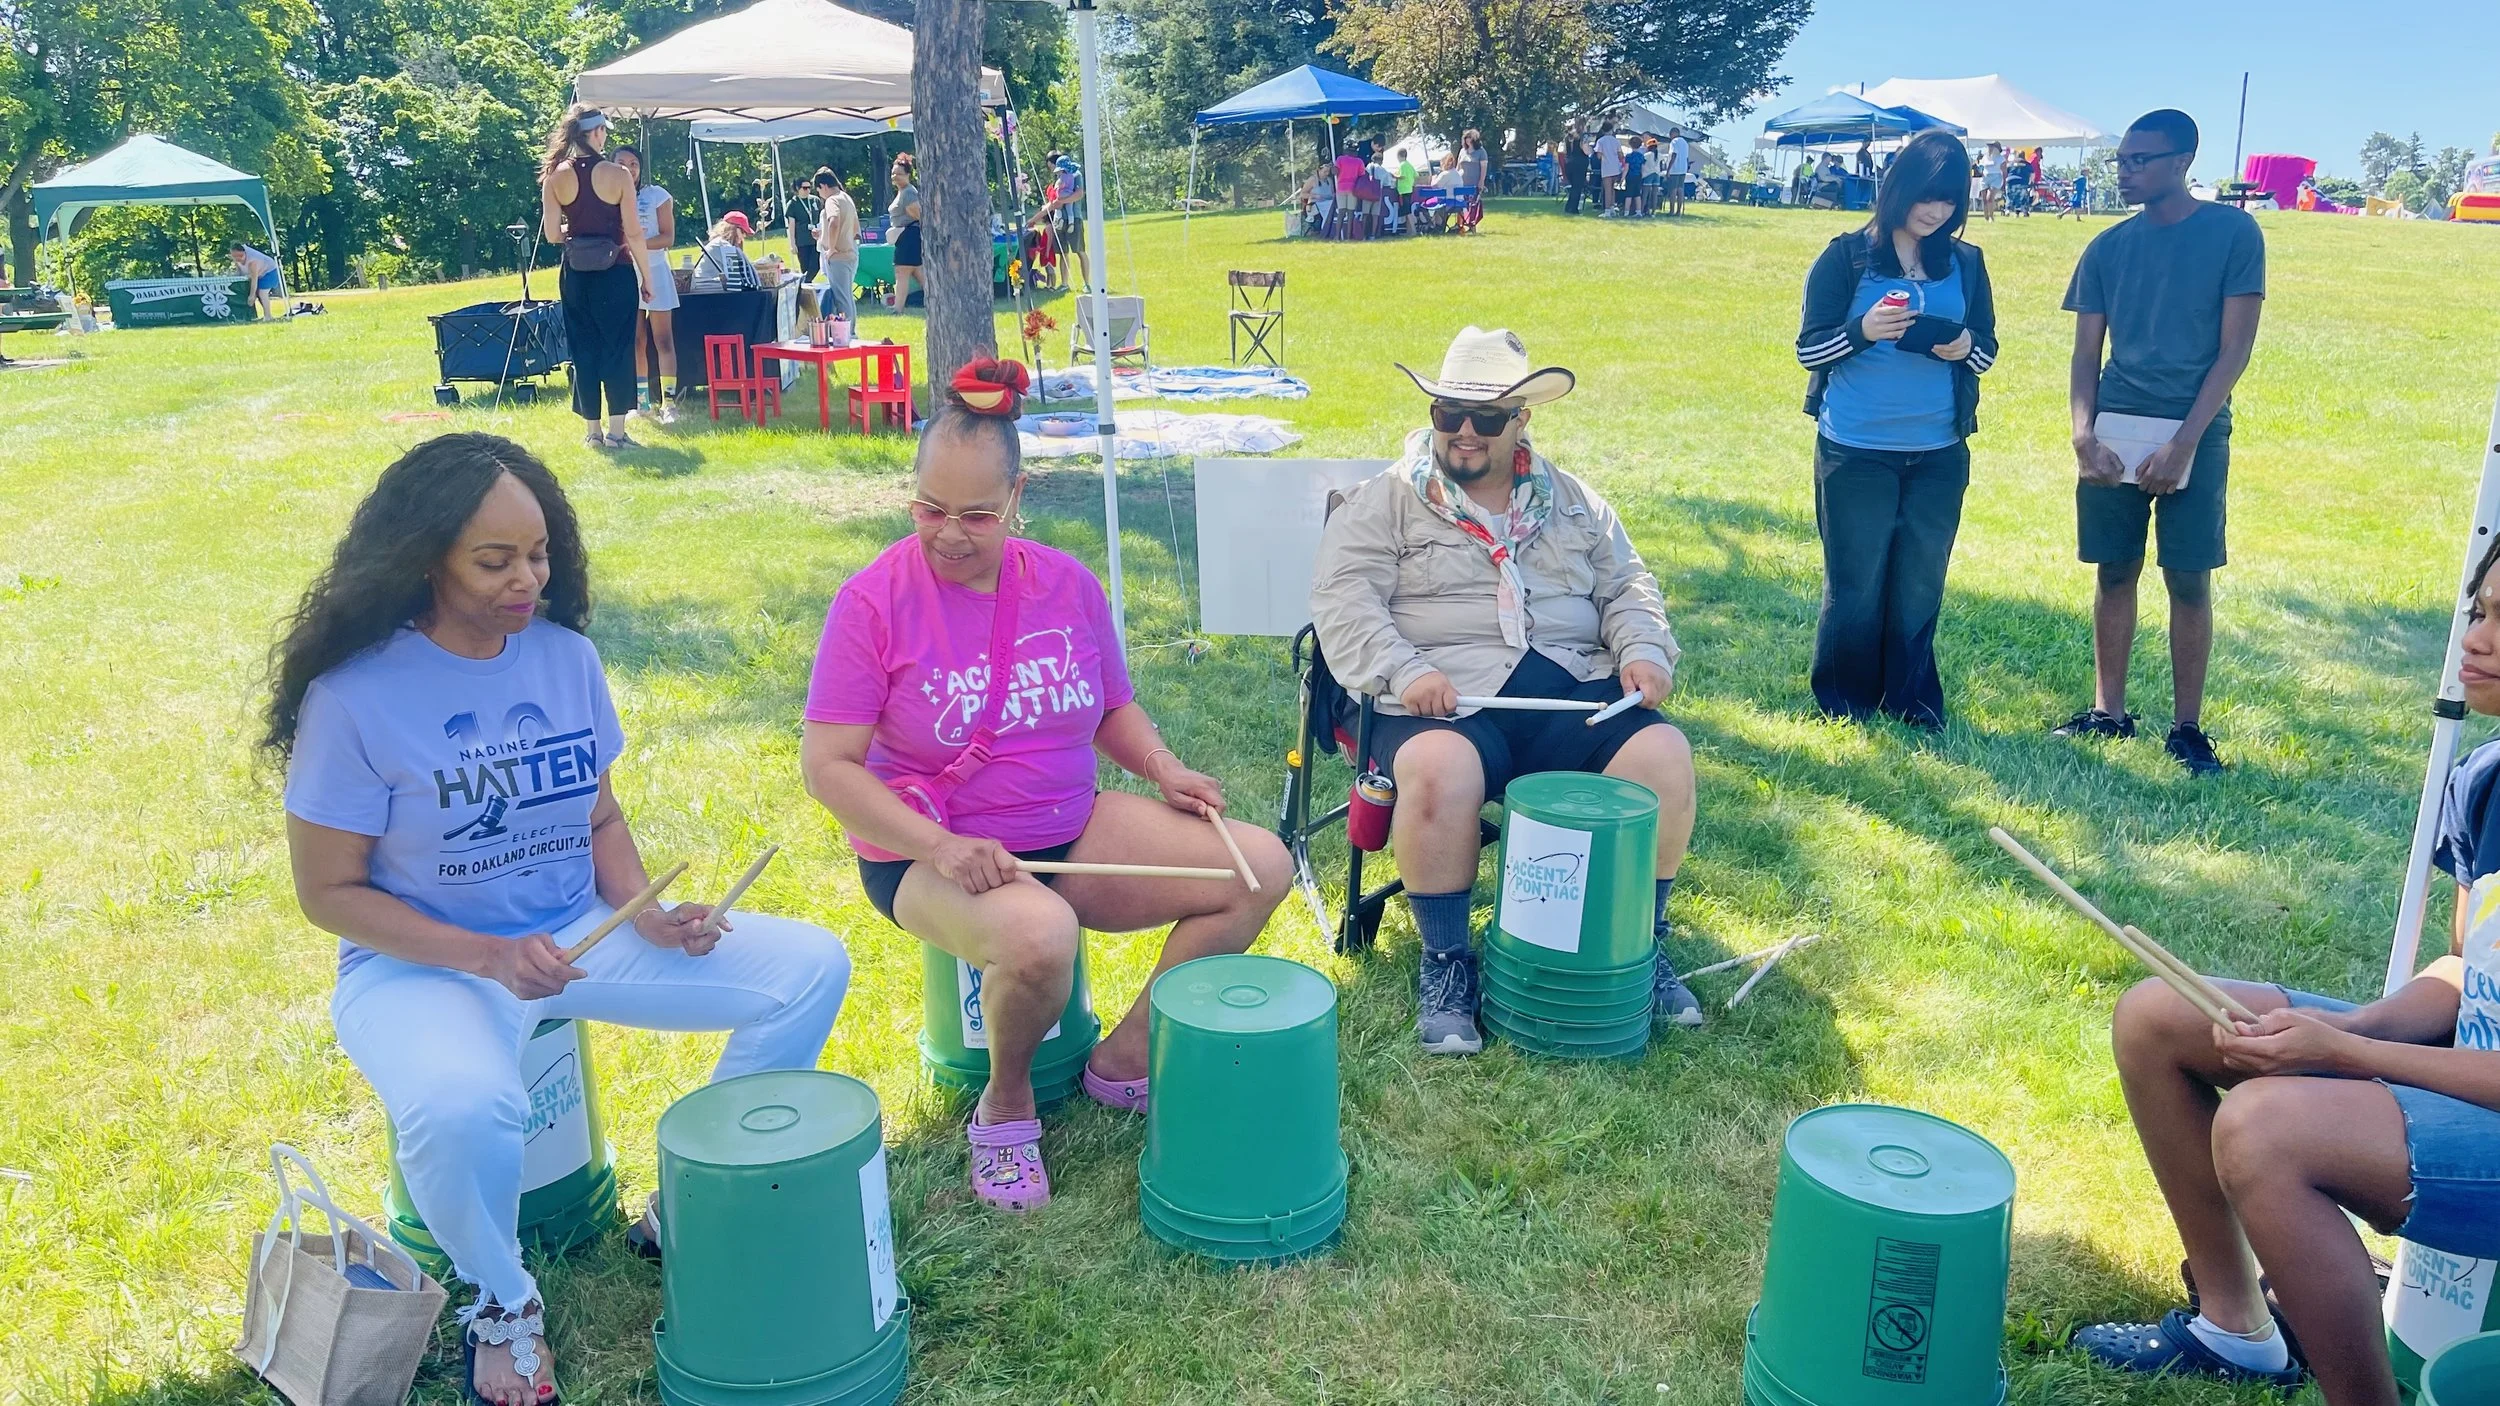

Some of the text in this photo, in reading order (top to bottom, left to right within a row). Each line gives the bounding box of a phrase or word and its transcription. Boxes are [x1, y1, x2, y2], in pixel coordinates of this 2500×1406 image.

[136, 288, 176, 299] OAKLAND
[177, 284, 210, 294] COUNTY
[947, 657, 1061, 696] ACNT
[961, 680, 1095, 724] PNTIAC
[460, 739, 529, 762] NADINE
[433, 740, 598, 809] HATTEN
[512, 825, 557, 843] ELECT
[438, 835, 591, 877] FOR OAKLAND CIRCUIT JU
[1512, 860, 1568, 883] ACCENT
[1515, 877, 1580, 901] PONTIAC
[528, 1075, 568, 1110] ENT
[523, 1088, 581, 1134] ONTIAC
